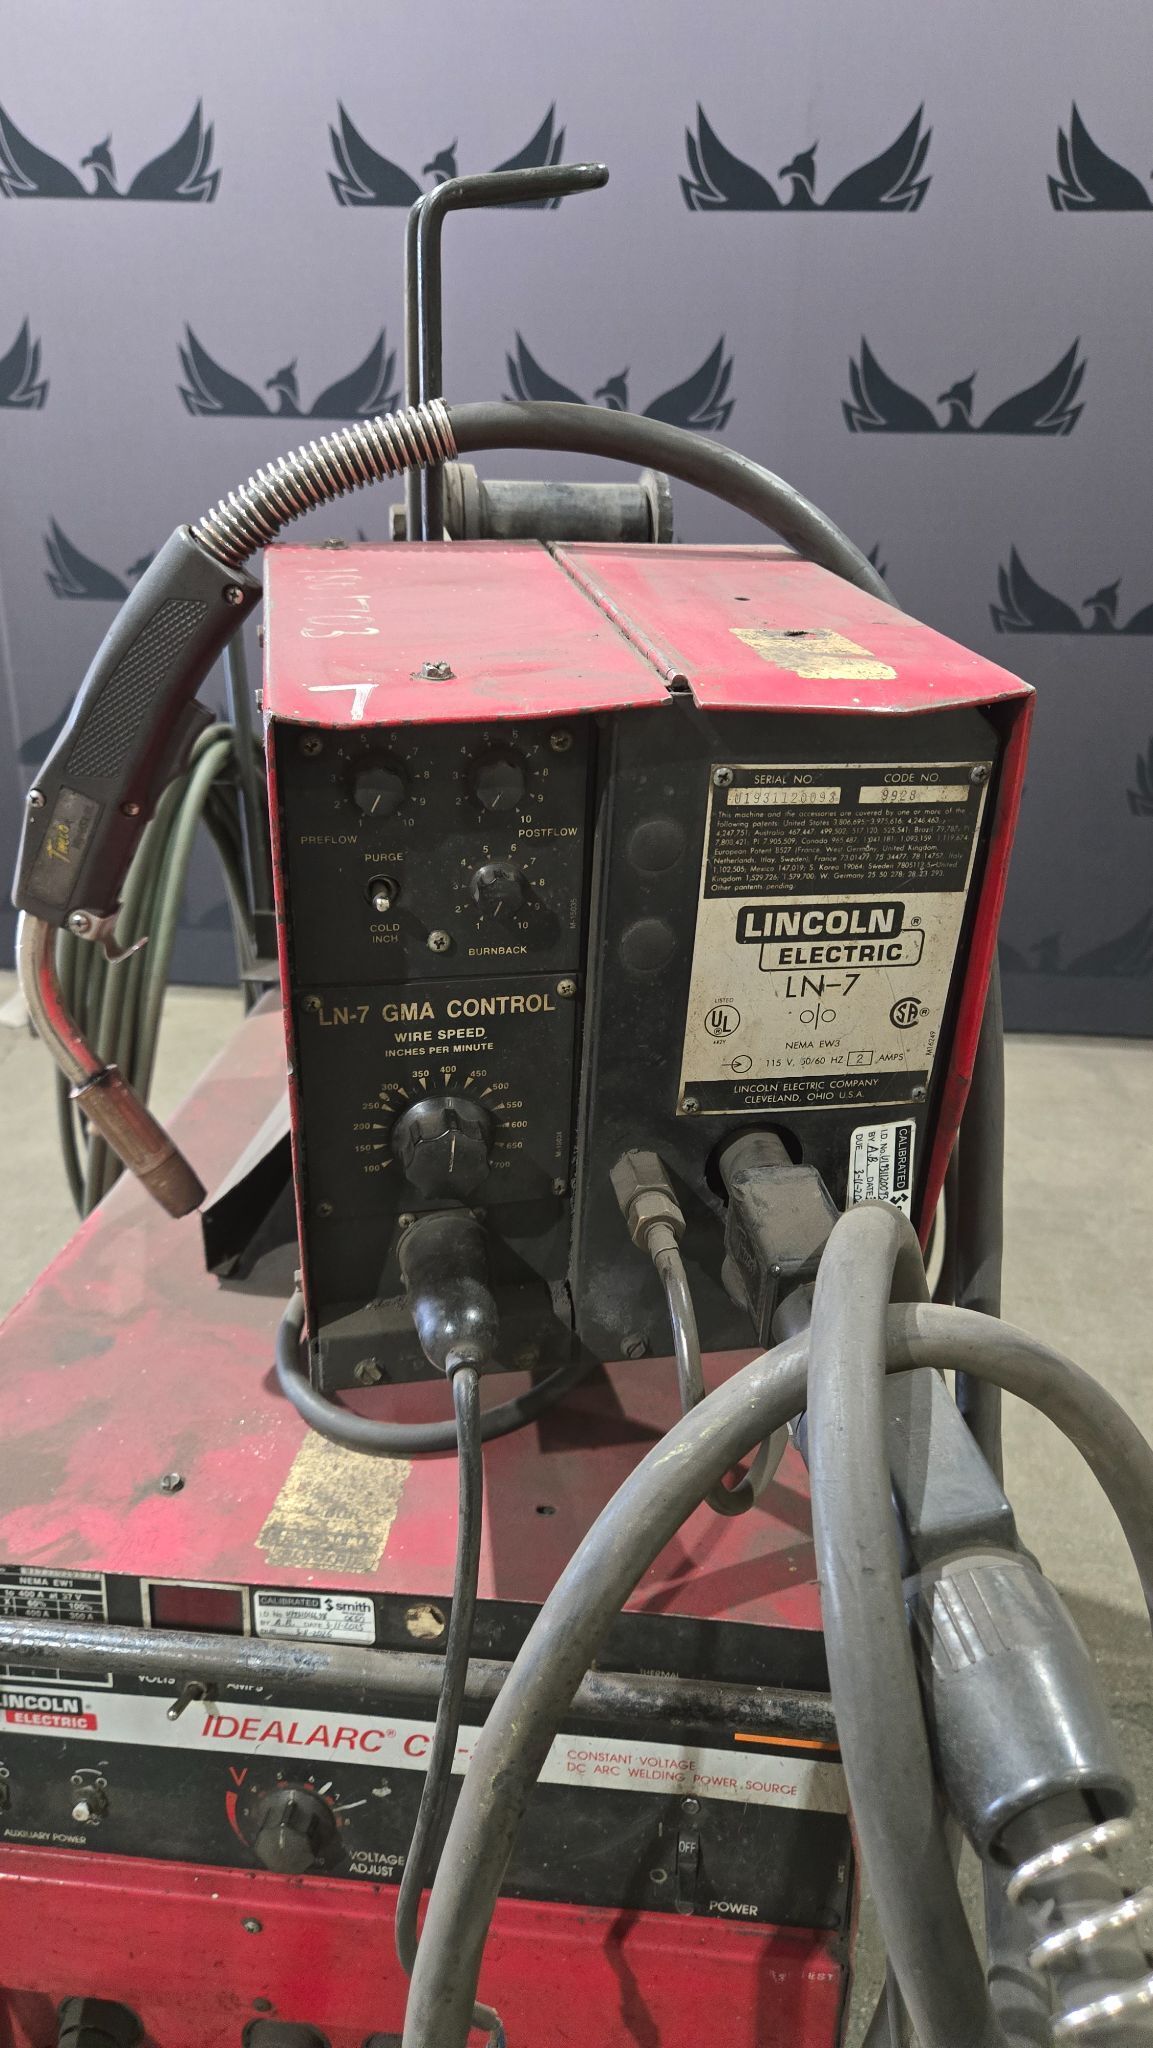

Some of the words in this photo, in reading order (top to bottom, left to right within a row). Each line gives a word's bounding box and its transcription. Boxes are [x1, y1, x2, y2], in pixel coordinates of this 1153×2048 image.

[460, 746, 467, 755] 4
[423, 770, 430, 779] 8
[754, 774, 787, 785] SERIAL
[793, 774, 815, 784] NO.
[884, 773, 916, 783] CODE
[537, 794, 544, 803] 9
[881, 788, 917, 801] 9928
[334, 800, 341, 809] 2
[419, 797, 426, 806] 9
[455, 797, 462, 806] 2
[885, 809, 894, 818] by
[403, 818, 415, 826] 10
[520, 815, 532, 823] 10
[717, 820, 749, 829] following
[518, 827, 578, 838] POSTFLOW
[300, 835, 358, 845] PREFLOW
[483, 845, 489, 853] 5
[510, 843, 517, 852] 6
[714, 848, 747, 857] European
[750, 847, 772, 855] Patent
[364, 852, 404, 863] PURGE
[460, 858, 467, 866] 4
[530, 857, 536, 865] 7
[818, 863, 840, 871] Korea
[868, 862, 895, 870] Sweden
[539, 878, 545, 887] 8
[712, 875, 742, 884] Kingdom
[833, 872, 865, 880] Germany
[711, 884, 732, 892] Other
[455, 905, 462, 913] 2
[534, 902, 541, 911] 9
[370, 923, 400, 933] COLD
[518, 921, 529, 929] 10
[744, 908, 896, 938] LINCOLN
[372, 934, 399, 944] INCH
[468, 945, 528, 956] BURNBACK
[778, 944, 903, 966] ELECTRIC
[785, 973, 861, 998] LN-7
[318, 1005, 370, 1026] LN-7
[382, 1001, 435, 1023] GMA
[446, 993, 556, 1018] CONTROL
[711, 1010, 732, 1033] UL
[394, 1031, 433, 1043] WIRE
[437, 1027, 486, 1040] SPEED
[785, 1041, 815, 1050] NEMA
[819, 1039, 841, 1049] EW3
[385, 1047, 426, 1058] INCHES
[429, 1045, 450, 1055] PER
[453, 1042, 494, 1053] MINUTE
[766, 1058, 781, 1067] 115
[830, 1055, 844, 1064] HZ
[856, 1053, 865, 1064] 2
[878, 1052, 904, 1062] AMPS
[412, 1069, 430, 1078] 350
[440, 1065, 457, 1074] 400
[470, 1069, 487, 1078] 450
[382, 1083, 399, 1091] 300
[492, 1082, 509, 1091] 500
[733, 1082, 779, 1094] LINCOLN
[783, 1081, 825, 1092] ELECTRIC
[829, 1078, 879, 1090] COMPANY
[807, 1091, 835, 1101] OHIO
[362, 1101, 380, 1110] 250
[506, 1100, 523, 1109] 550
[353, 1122, 371, 1131] 200
[511, 1120, 528, 1129] 600
[868, 1131, 876, 1142] BY
[506, 1141, 523, 1150] 650
[855, 1133, 864, 1151] DUE
[355, 1144, 371, 1153] 150
[896, 1128, 908, 1189] CALIBRATED
[364, 1164, 381, 1173] 100
[494, 1160, 511, 1169] 700
[19, 1577, 49, 1586] NEMA
[260, 1596, 319, 1608] CALIBRATED
[335, 1601, 371, 1613] smith
[0, 1694, 79, 1714] INCOLN
[14, 1712, 88, 1729] ELECTRIC
[567, 1749, 633, 1765] CONSTANT
[639, 1756, 696, 1771] VOLTAGE
[229, 1767, 249, 1787] V
[566, 1762, 585, 1775] DC
[594, 1764, 621, 1777] ARC
[628, 1768, 686, 1783] WELDING
[693, 1773, 737, 1789] POWER
[745, 1779, 798, 1796] SOURCE
[4, 1828, 51, 1841] AUXILIARY
[52, 1833, 87, 1844] POWER
[679, 1840, 697, 1855] OFF
[349, 1850, 405, 1866] VOLTAGE
[350, 1865, 393, 1878] ADJUST
[709, 1899, 758, 1916] POWER
